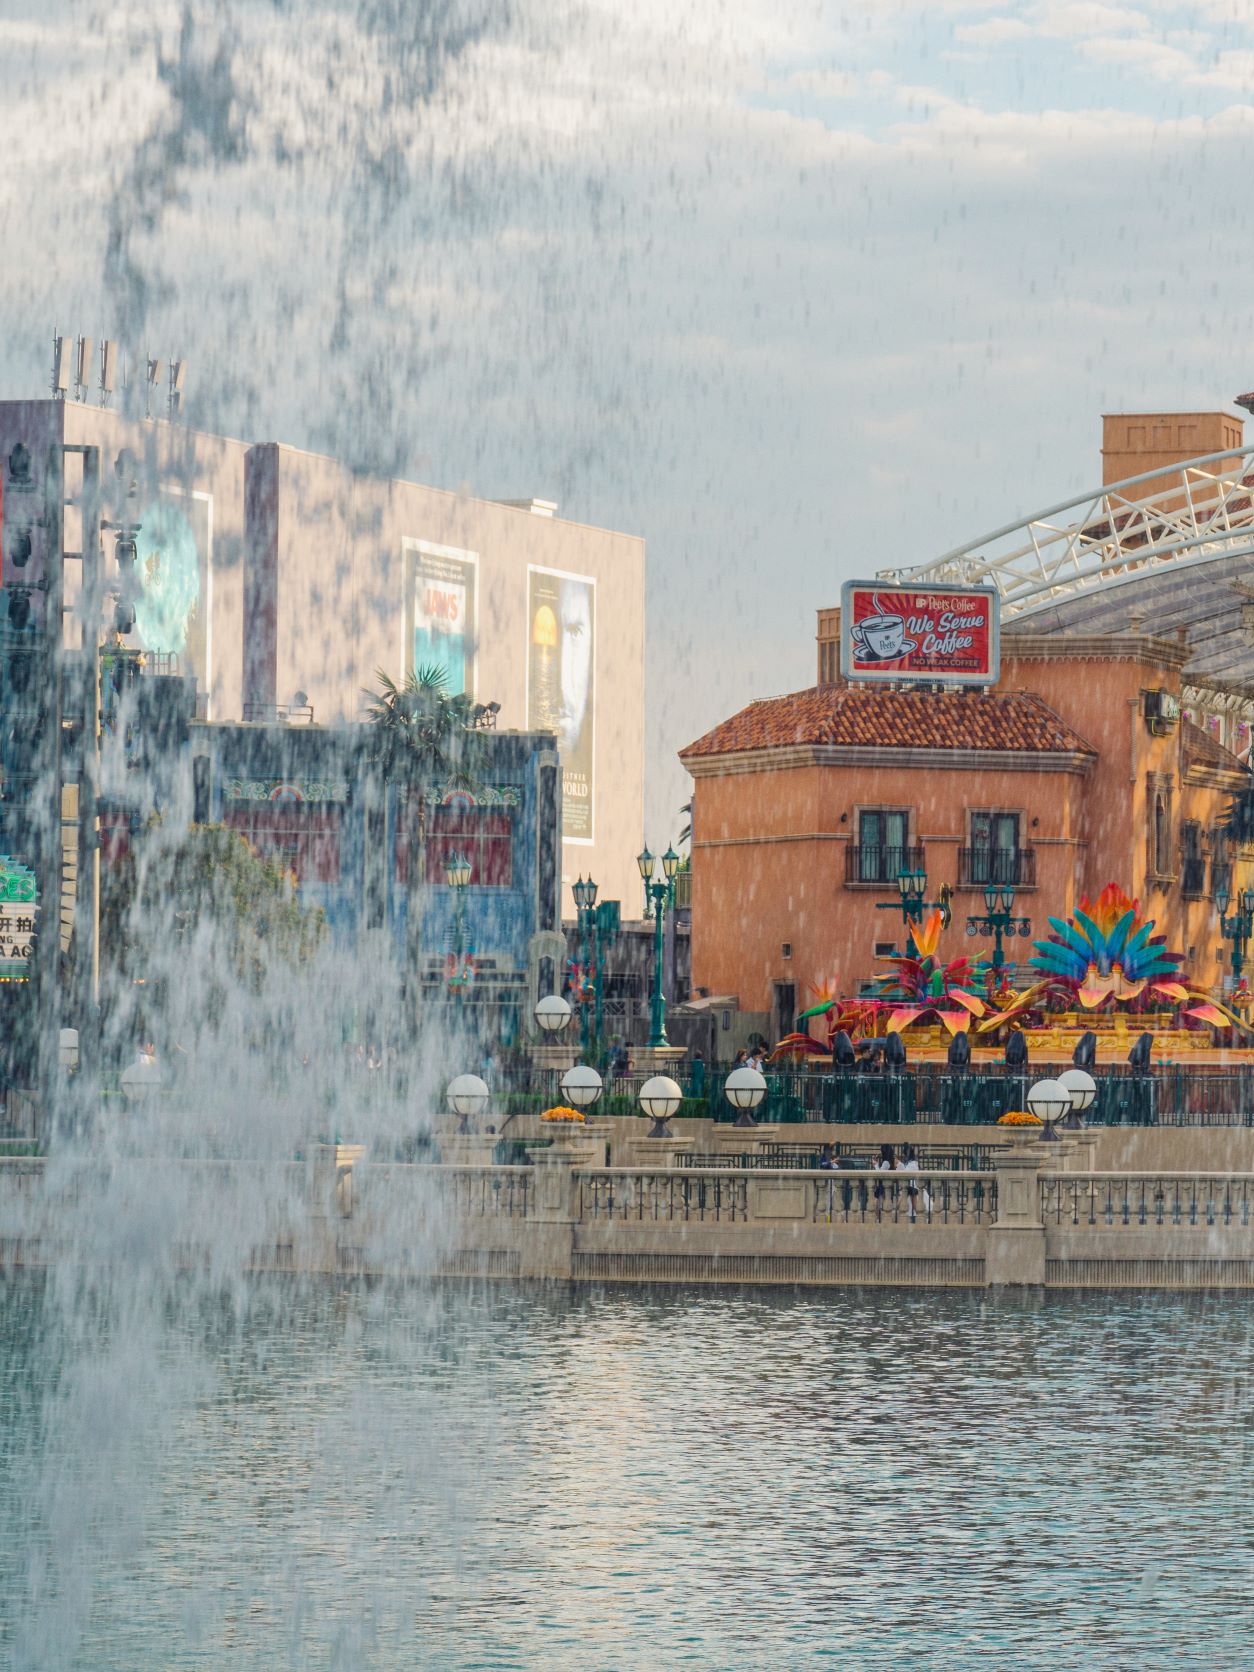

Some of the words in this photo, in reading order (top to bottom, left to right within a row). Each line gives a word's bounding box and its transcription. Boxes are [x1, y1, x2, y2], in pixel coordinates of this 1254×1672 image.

[424, 588, 458, 621] JAWS
[951, 598, 976, 612] Coffee
[906, 614, 934, 634] We
[937, 612, 984, 632] Serve
[922, 631, 973, 654] Coffee
[927, 658, 949, 666] WEAK
[950, 658, 979, 667] COFFEE
